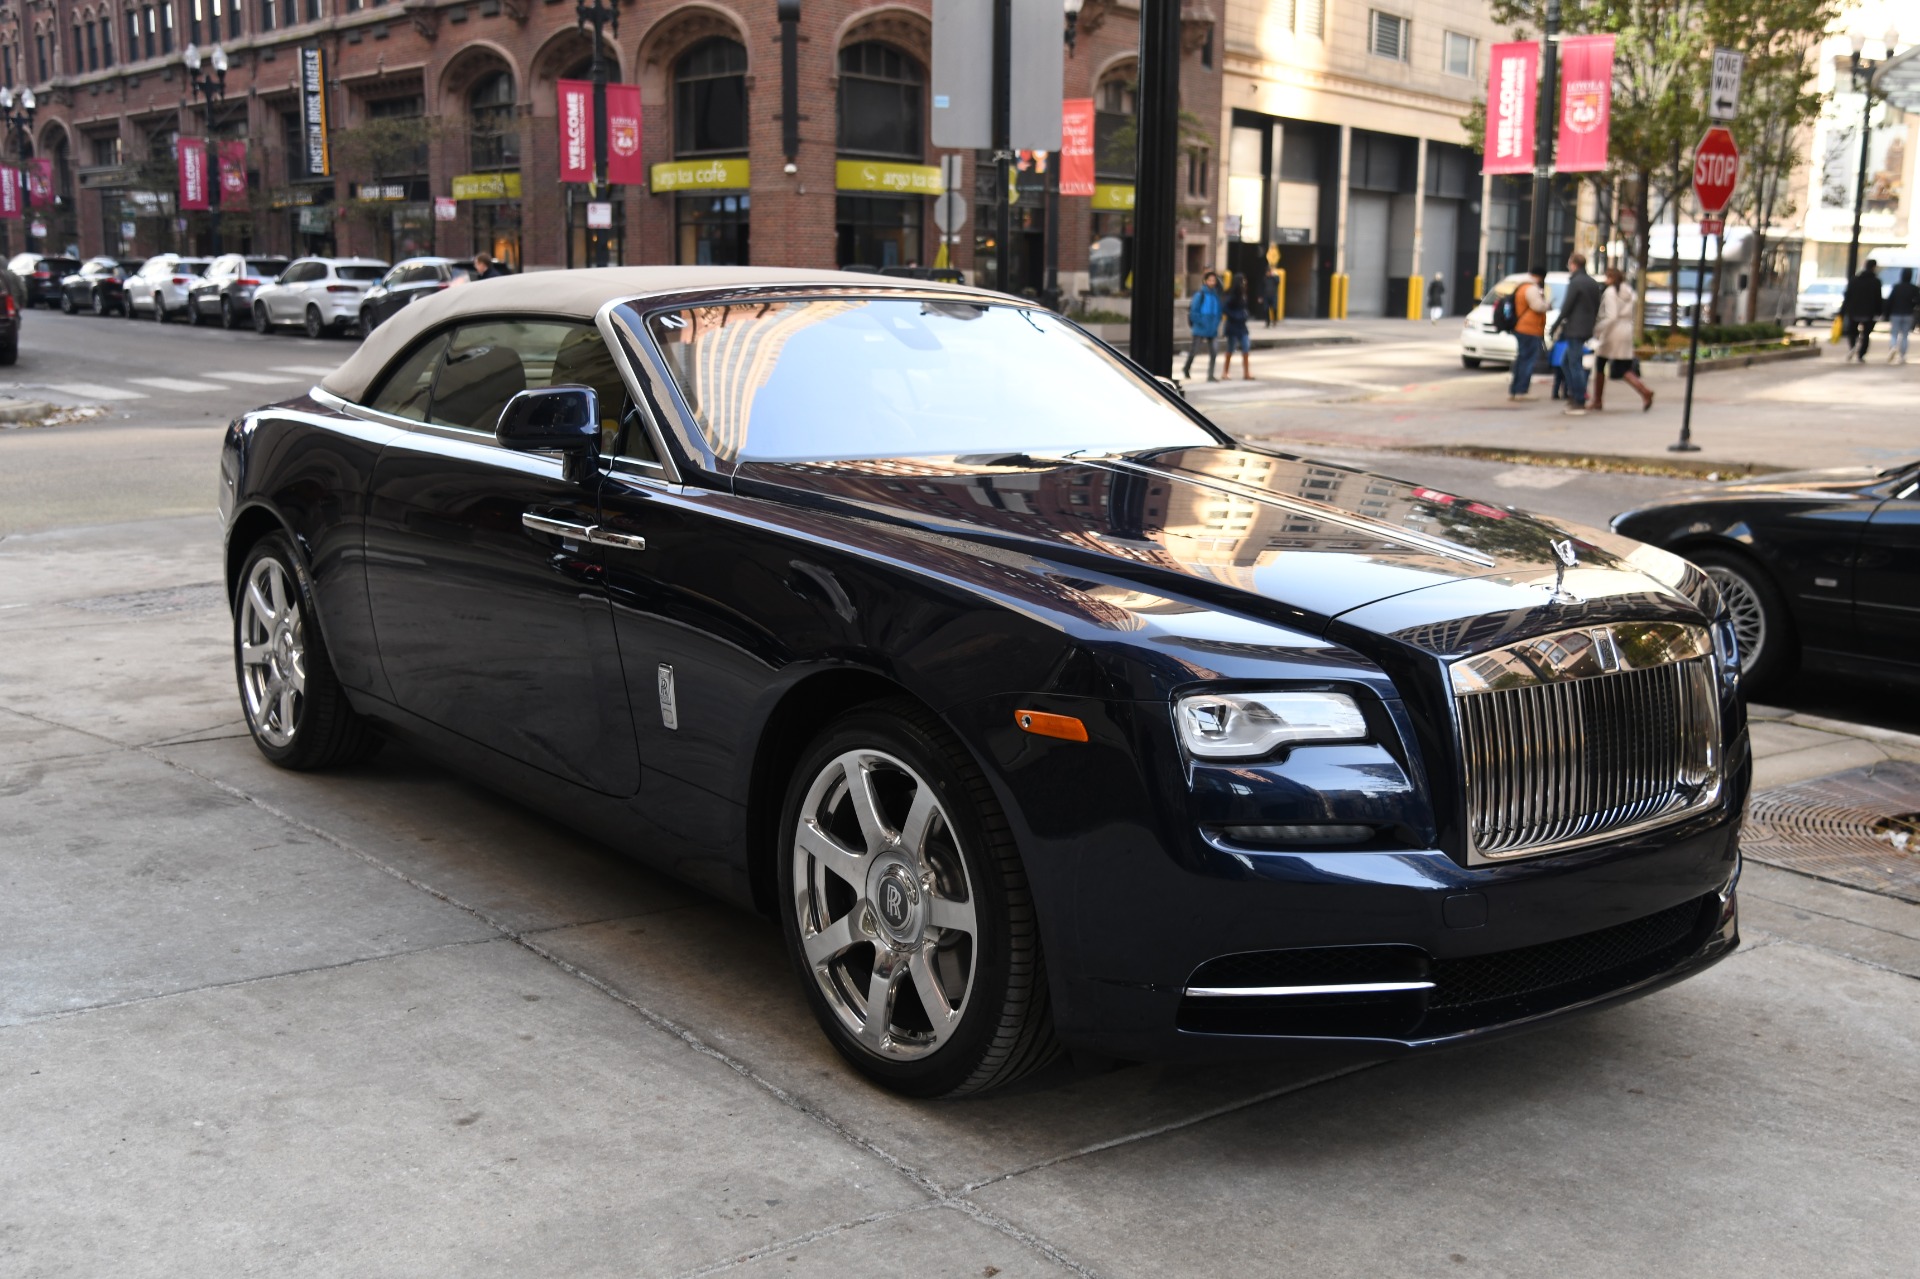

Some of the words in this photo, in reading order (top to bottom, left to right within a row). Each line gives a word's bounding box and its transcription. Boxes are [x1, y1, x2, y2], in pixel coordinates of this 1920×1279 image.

[304, 49, 320, 91] BAGELS
[1714, 76, 1736, 91] WAY
[1716, 57, 1738, 75] ONE
[1566, 80, 1605, 92] LOYOLA
[1496, 57, 1518, 158] WELCOME
[566, 91, 580, 170] WELCOME
[309, 125, 324, 174] EINSTEIN
[183, 146, 197, 202] WELCOME
[677, 169, 694, 184] tea
[695, 160, 727, 183] café
[882, 171, 911, 191] argo
[912, 171, 926, 187] tea
[1695, 153, 1736, 188] STOP
[1, 167, 13, 212] WELCOME
[886, 883, 902, 920] RR
